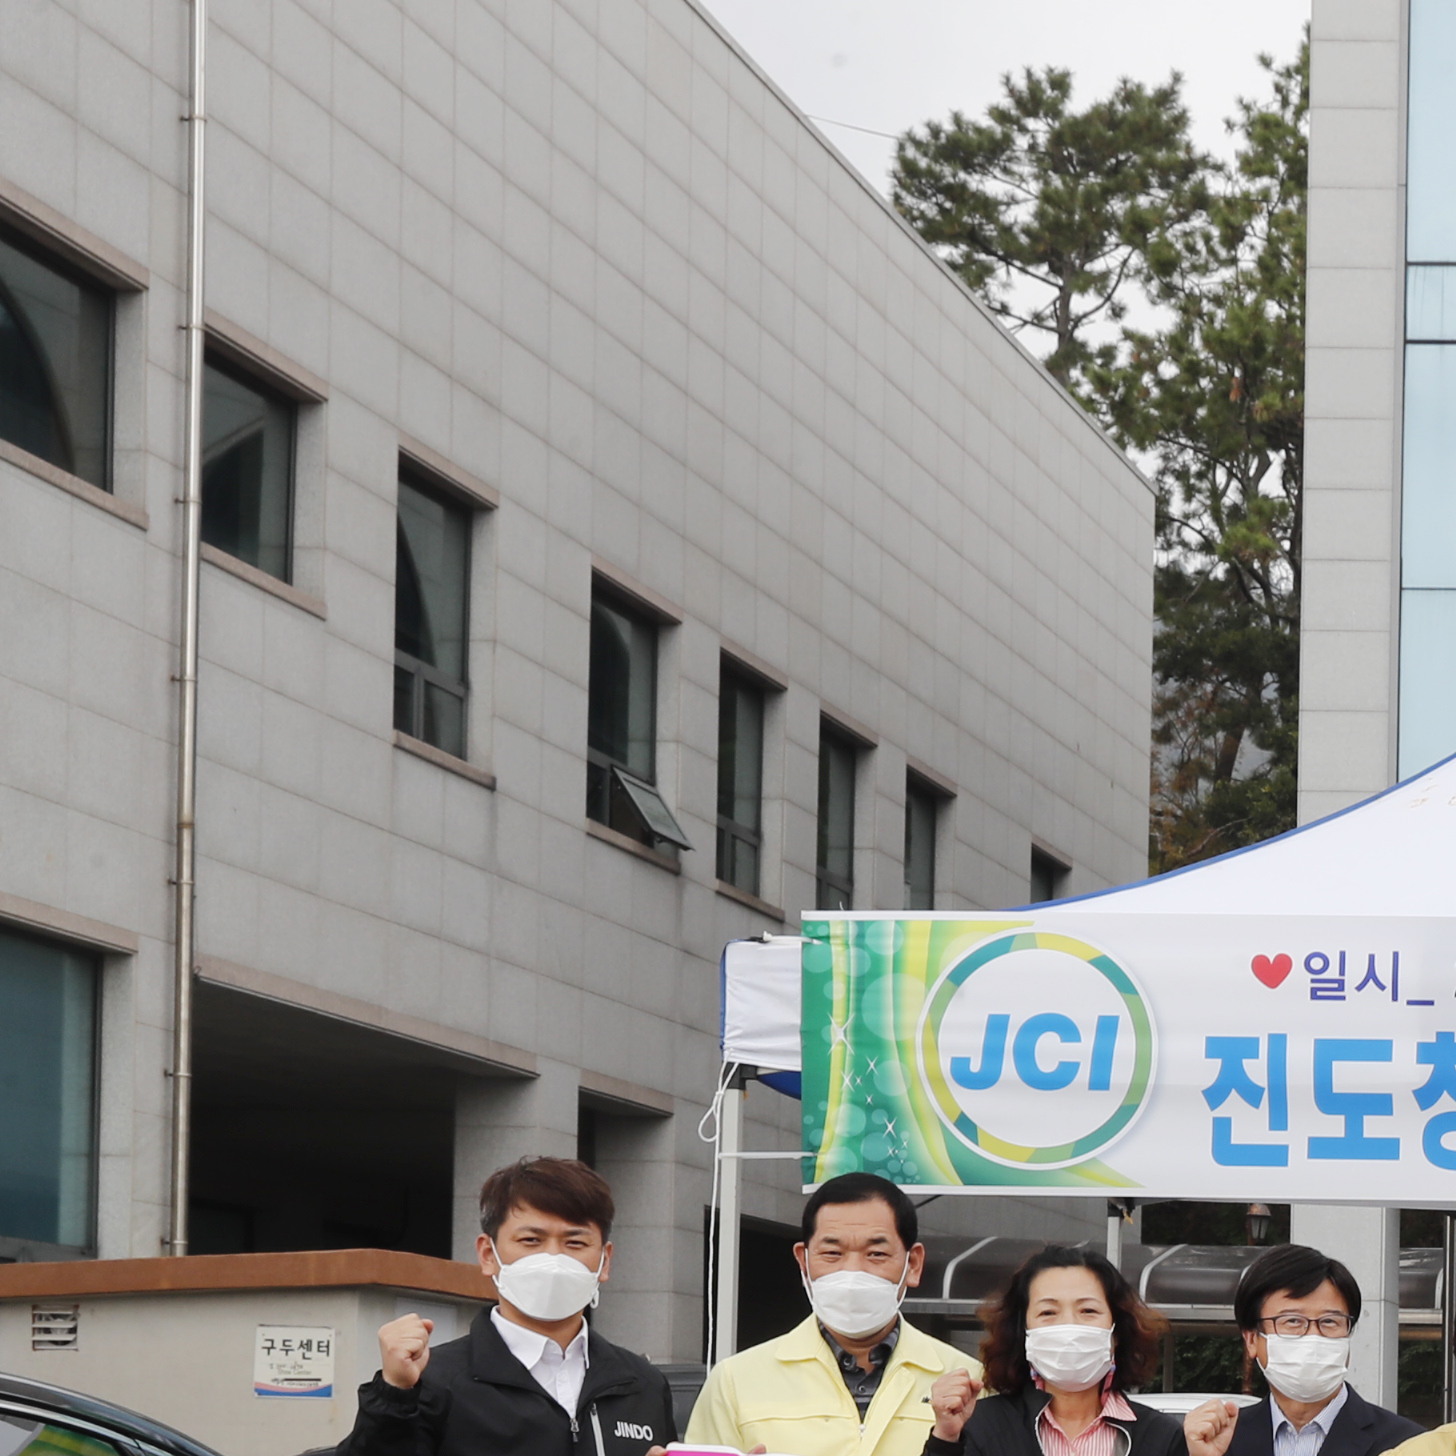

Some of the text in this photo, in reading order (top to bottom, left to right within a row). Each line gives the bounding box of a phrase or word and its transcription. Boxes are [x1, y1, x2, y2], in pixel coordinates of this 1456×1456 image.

[1304, 951, 1435, 1006] 일시_
[951, 1013, 1119, 1094] JCI
[261, 1338, 331, 1361] 구두센터
[614, 1421, 654, 1442] JINDO
